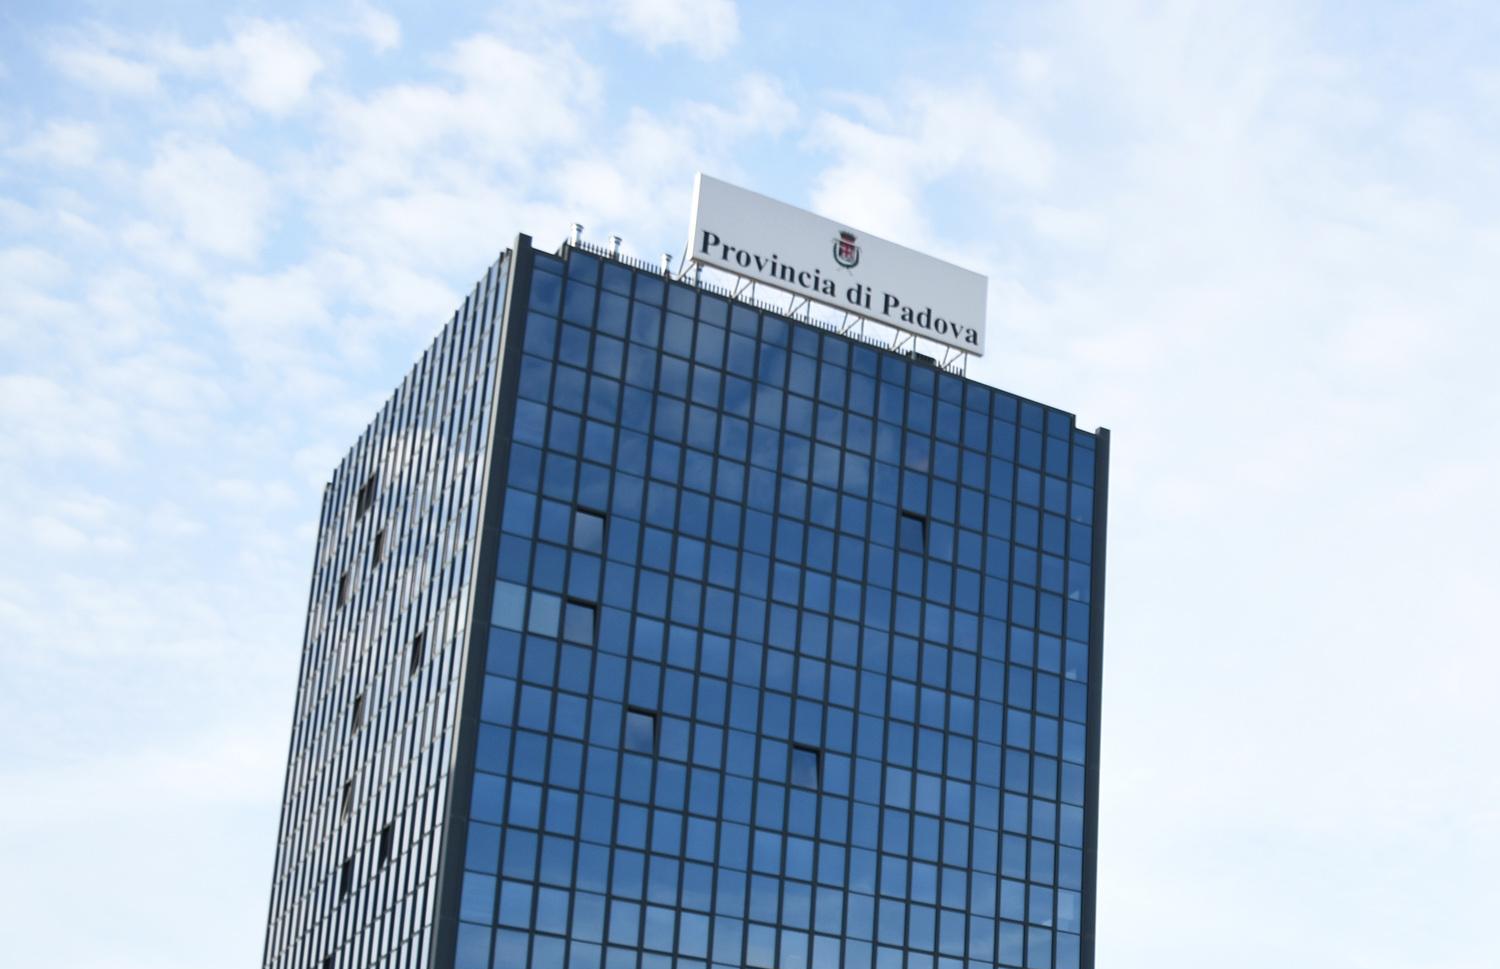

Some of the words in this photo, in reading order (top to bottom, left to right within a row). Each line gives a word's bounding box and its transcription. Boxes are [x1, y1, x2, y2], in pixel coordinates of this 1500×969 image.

[701, 230, 836, 298] Provincia
[847, 283, 872, 308] di
[882, 292, 979, 346] Padova
